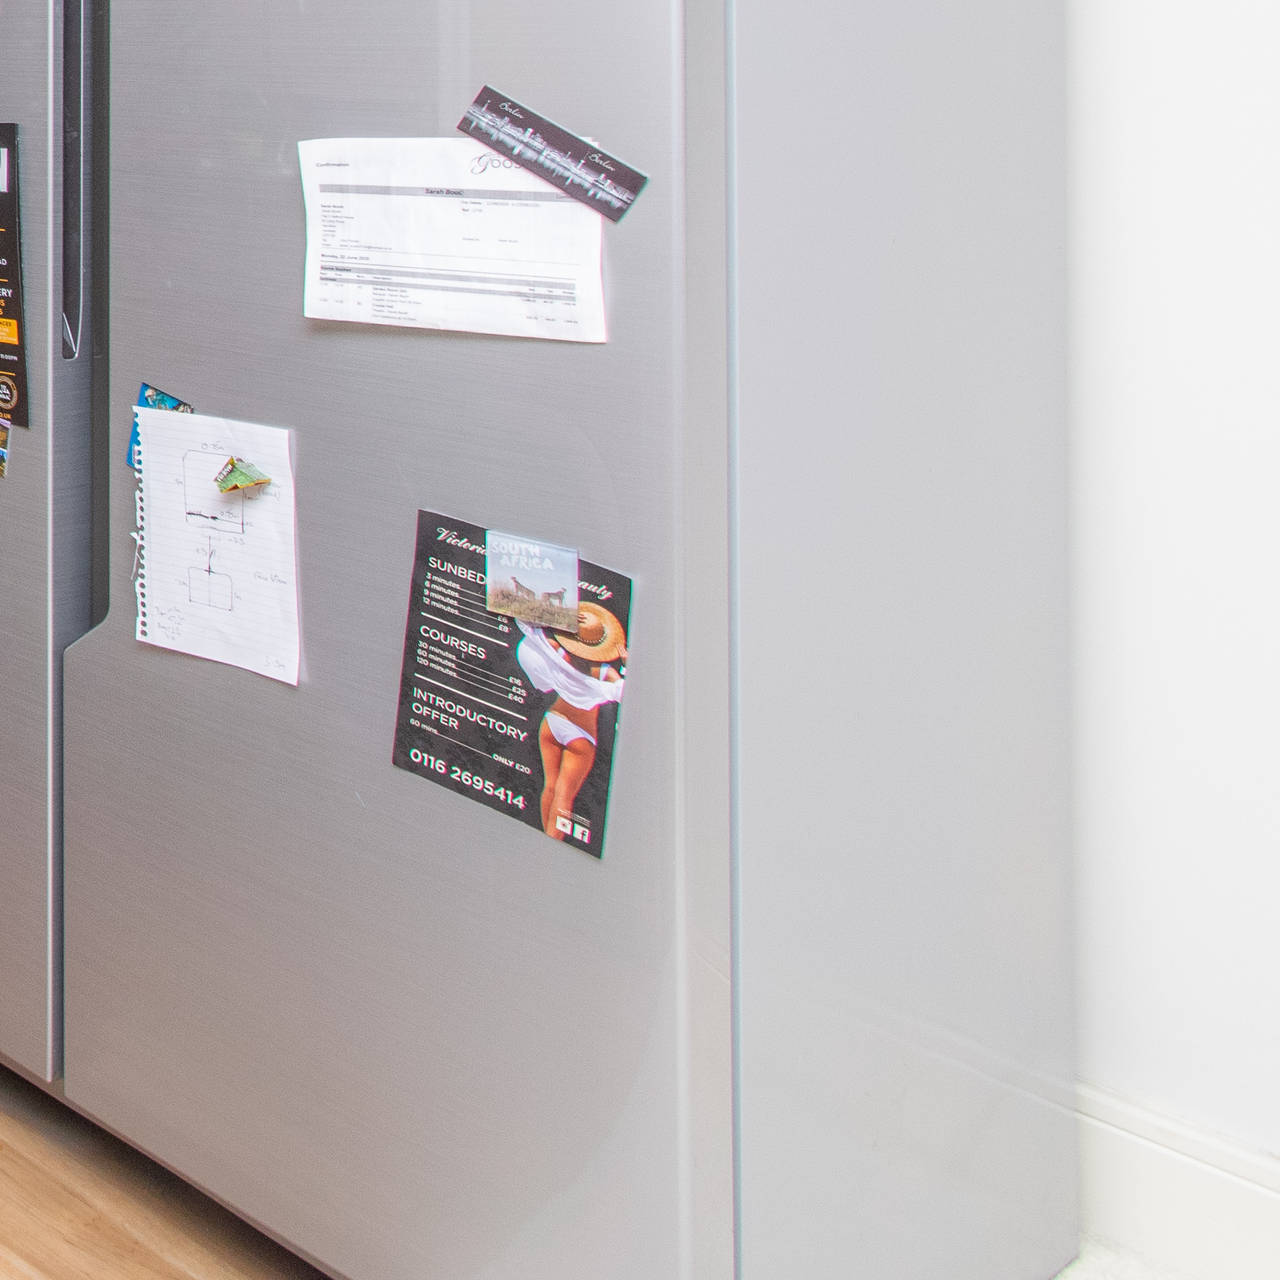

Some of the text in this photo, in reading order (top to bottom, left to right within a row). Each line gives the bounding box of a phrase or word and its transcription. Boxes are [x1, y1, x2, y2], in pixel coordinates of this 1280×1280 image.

[498, 102, 524, 120] Berlin
[589, 153, 616, 172] Berlin
[436, 527, 486, 555] Victori
[500, 554, 554, 571] AFRICA
[426, 572, 432, 580] 3
[424, 589, 430, 597] 9
[578, 581, 614, 600] auty
[423, 597, 431, 606] 12
[418, 640, 429, 649] 30
[419, 625, 487, 660] COURSES
[416, 656, 429, 666] 120
[508, 693, 525, 704] £40
[417, 648, 428, 657] 60
[512, 686, 528, 697] £25
[411, 702, 459, 730] OFFER
[413, 687, 528, 742] INTRODUCTORY
[492, 753, 515, 768] ONLY
[515, 762, 531, 775] £20
[410, 748, 527, 810] 0116 2695414
